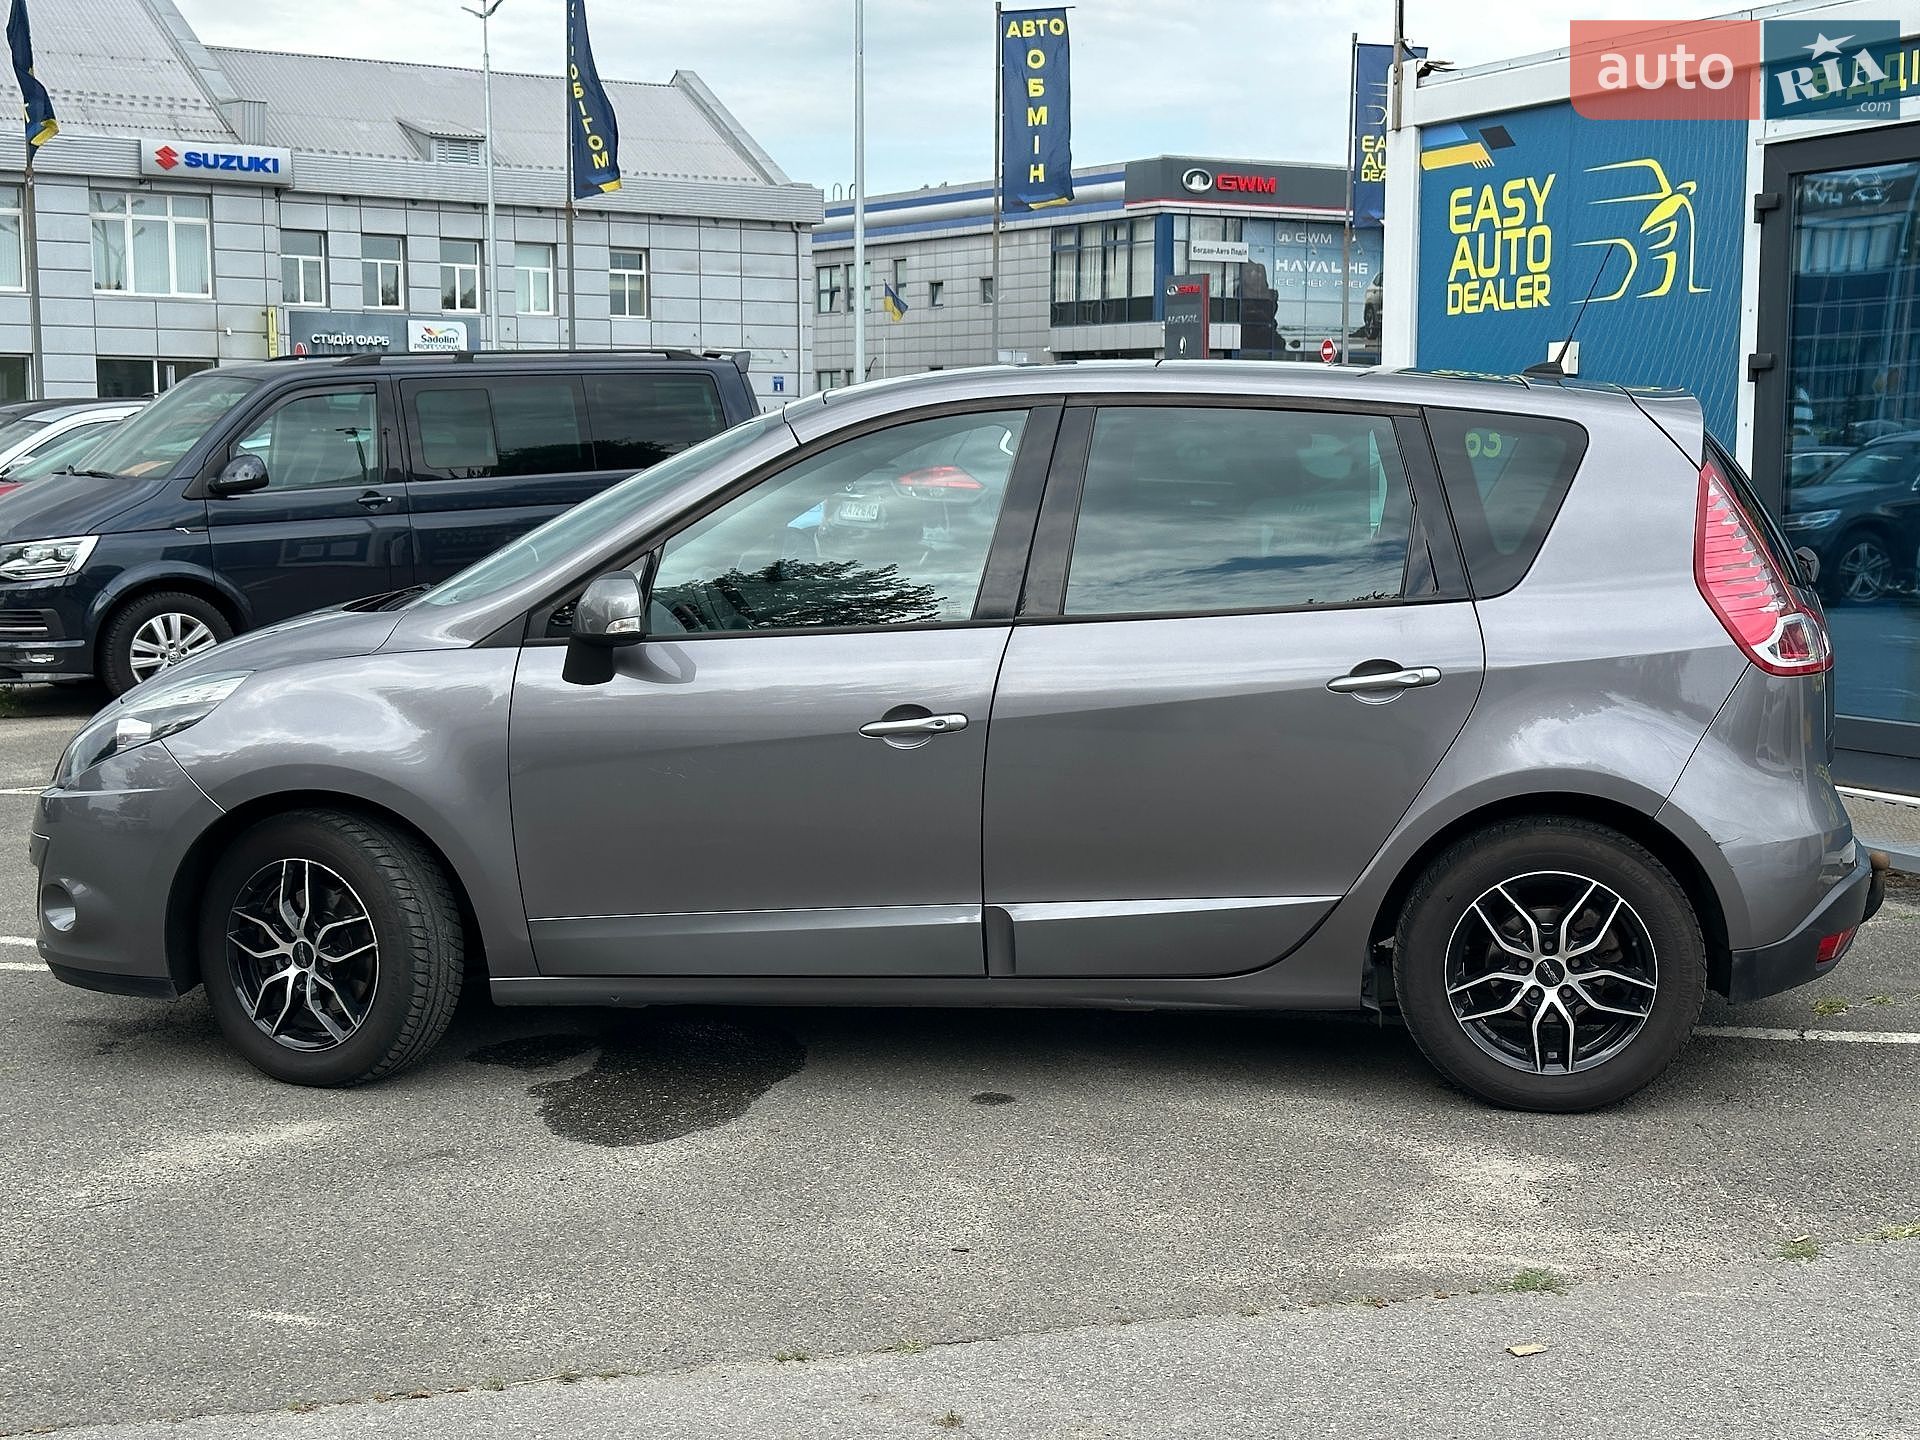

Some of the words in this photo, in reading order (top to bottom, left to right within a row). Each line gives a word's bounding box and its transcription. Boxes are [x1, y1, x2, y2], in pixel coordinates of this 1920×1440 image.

[1006, 18, 1065, 38] АВТО
[1026, 49, 1048, 183] ОБМІН
[1361, 135, 1387, 153] EA
[184, 151, 279, 173] SUZUKI
[1361, 152, 1387, 170] AU
[1216, 174, 1277, 194] GWM
[1361, 169, 1387, 182] DEA
[1449, 173, 1556, 234] EASY
[1295, 232, 1332, 244] GWM
[1448, 224, 1552, 282] AUTO
[1275, 259, 1342, 274] HAVAL
[1447, 273, 1551, 316] DEALER
